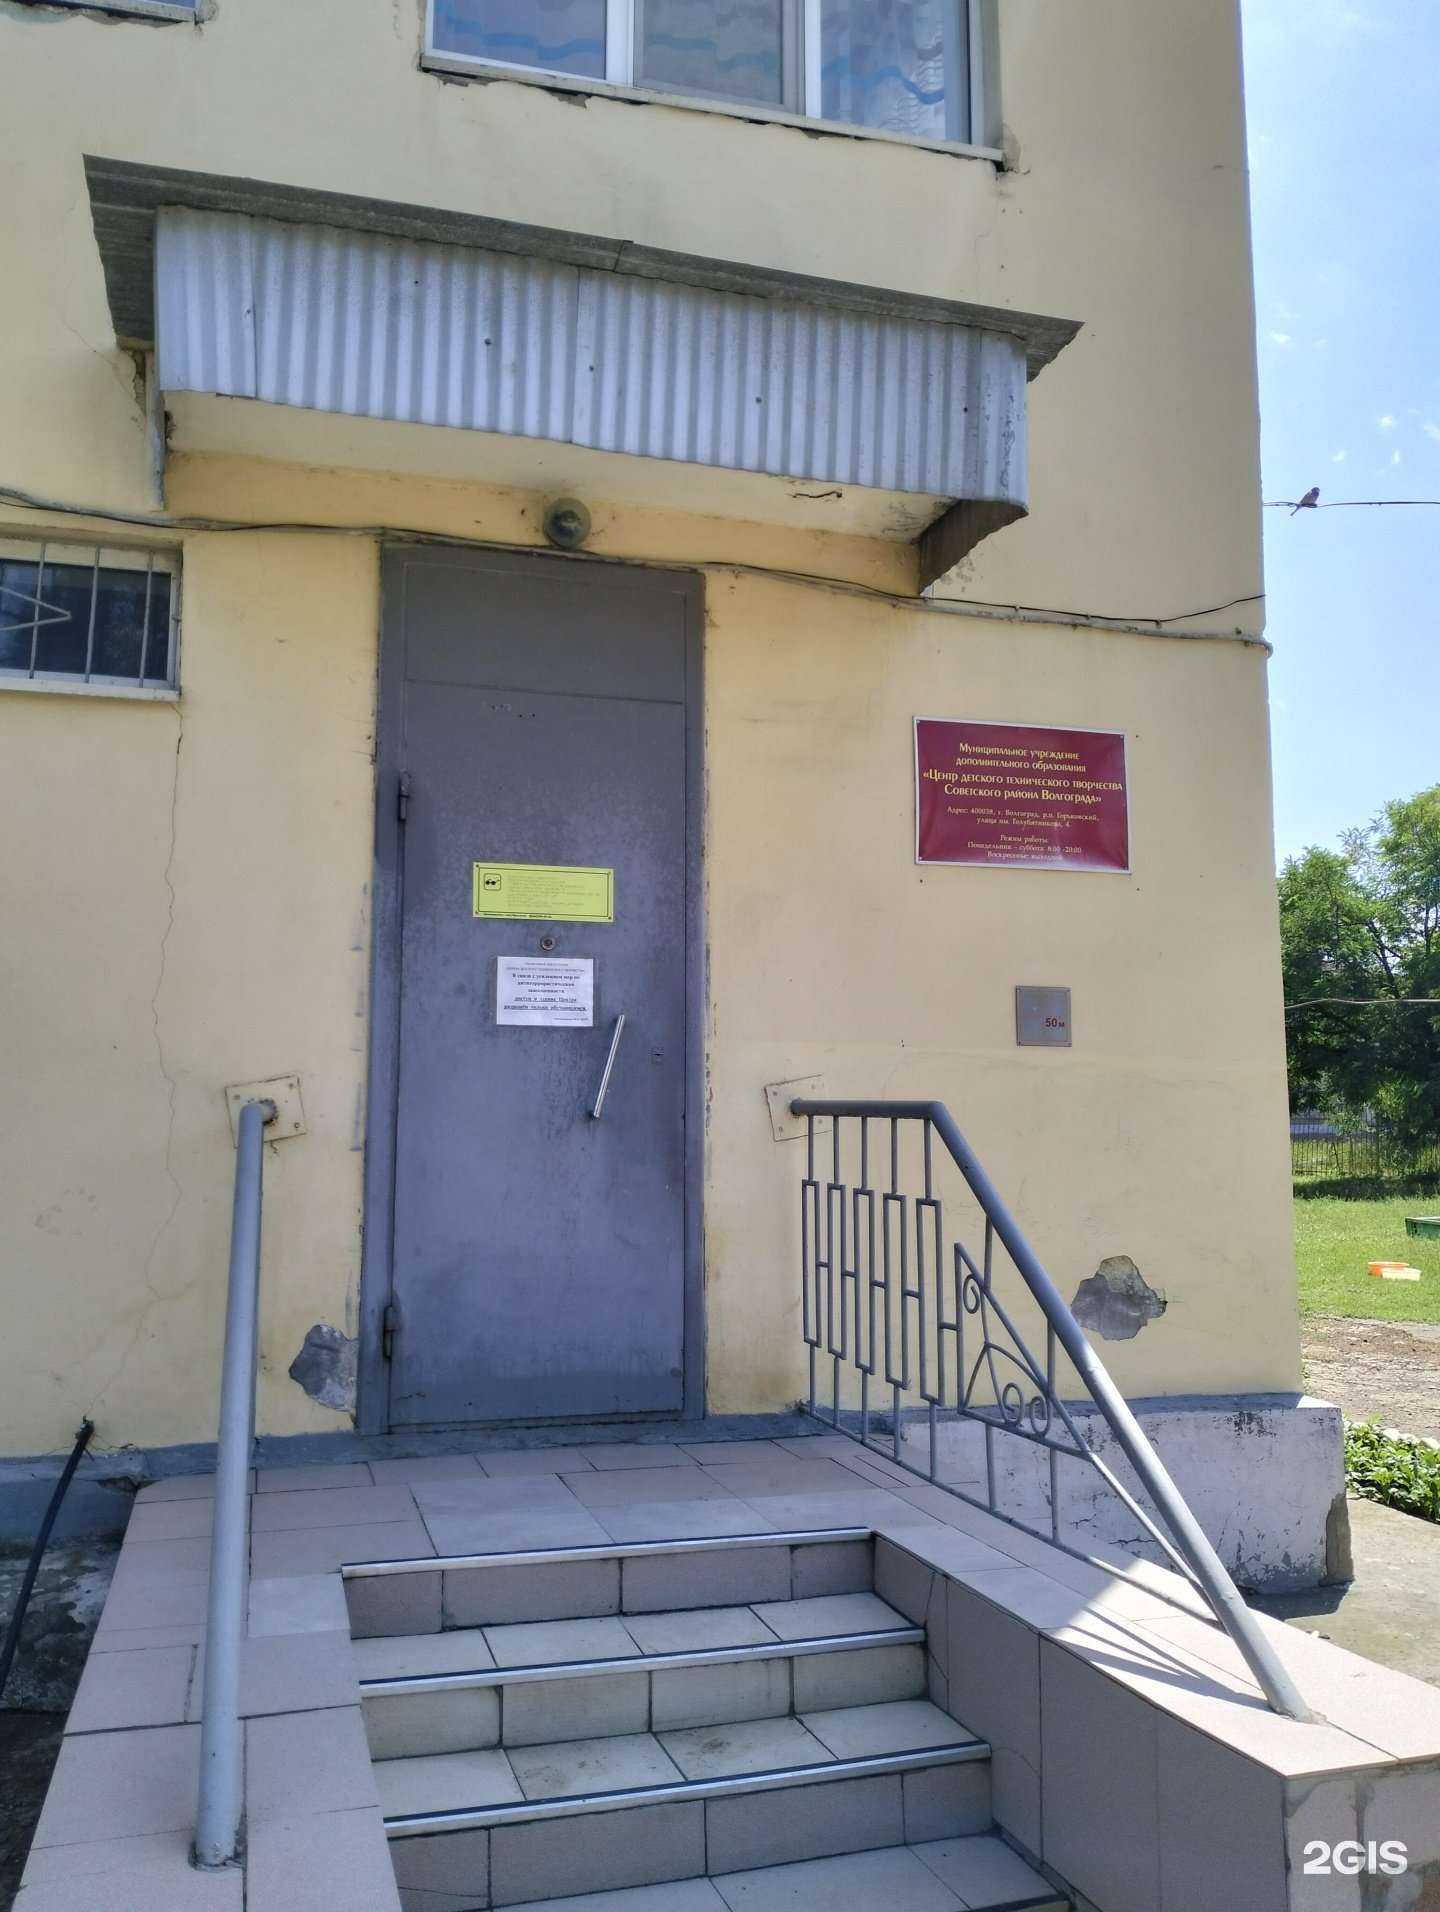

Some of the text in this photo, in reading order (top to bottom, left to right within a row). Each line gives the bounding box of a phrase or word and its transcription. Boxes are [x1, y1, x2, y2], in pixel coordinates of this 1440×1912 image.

[960, 742, 1080, 761] Муниципальное учреждение
[956, 757, 1086, 773] дополнительного образования
[923, 768, 1123, 792] «Центр детского технического творчества
[944, 783, 1102, 804] Советского района Волгограда»
